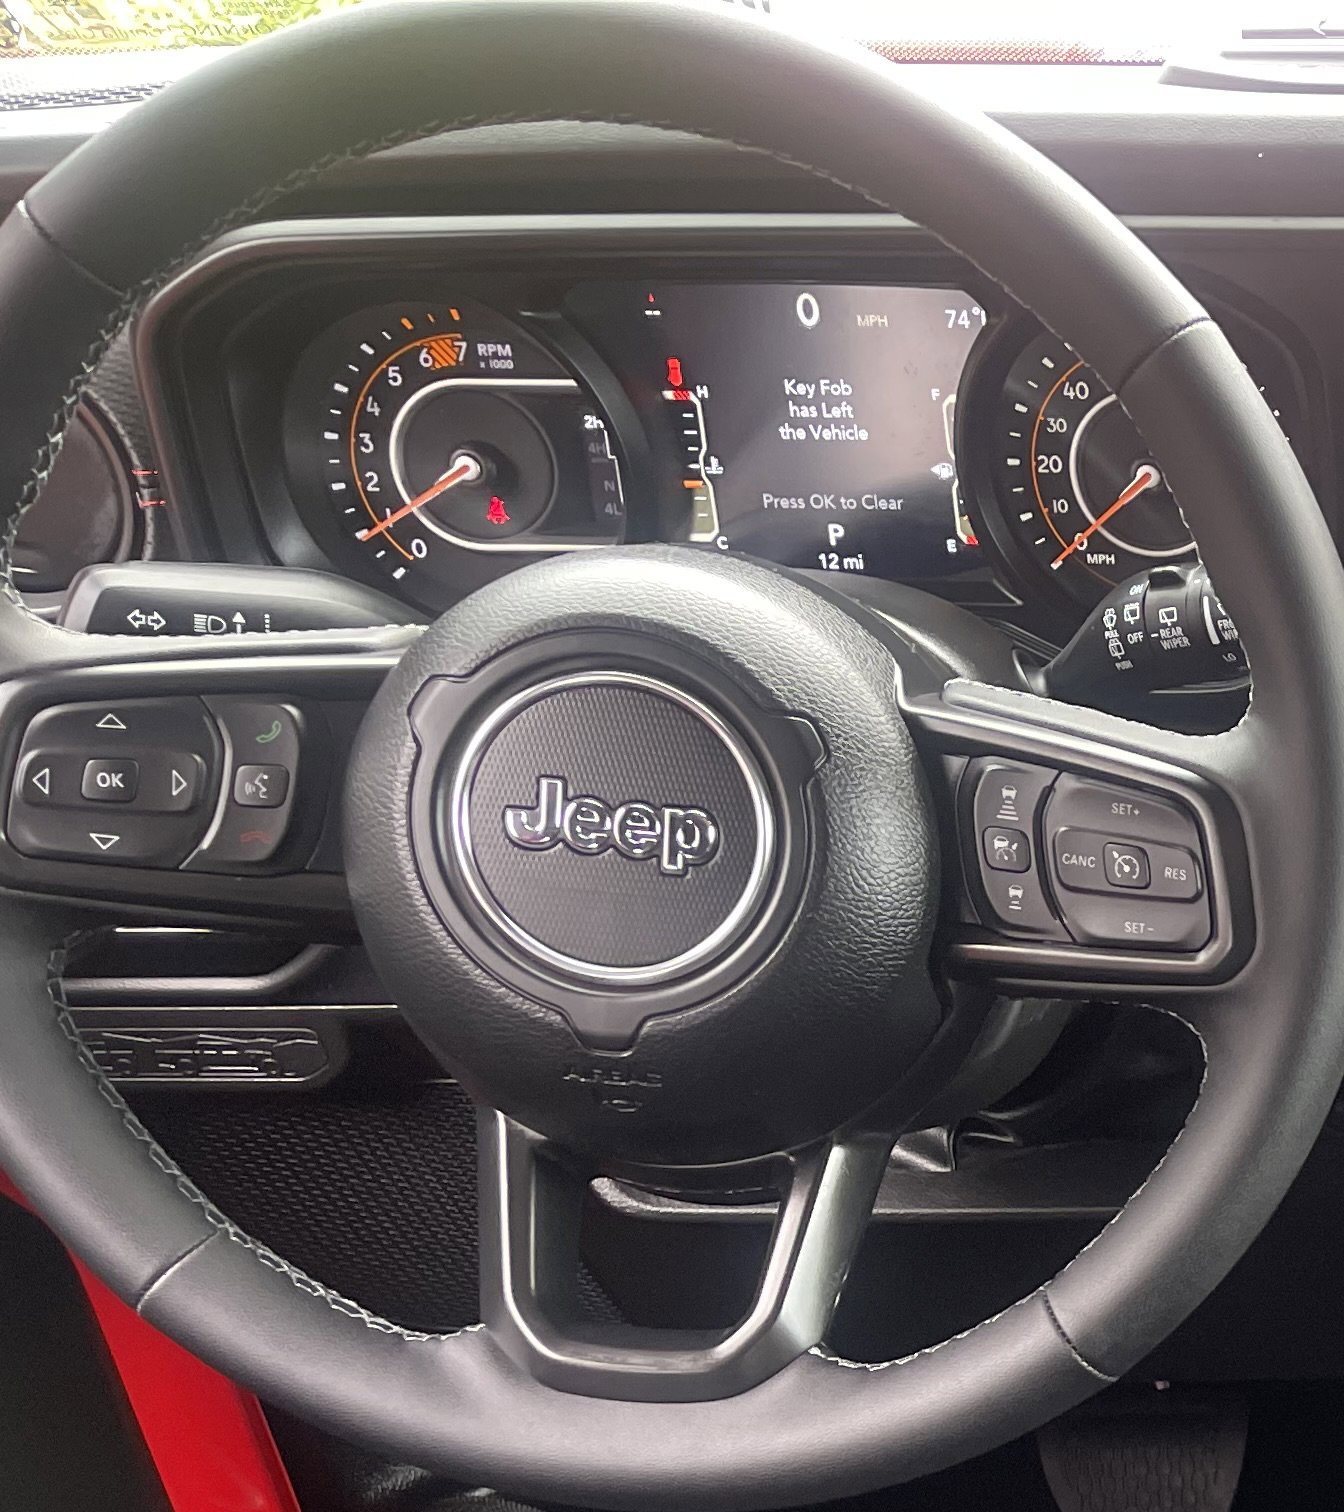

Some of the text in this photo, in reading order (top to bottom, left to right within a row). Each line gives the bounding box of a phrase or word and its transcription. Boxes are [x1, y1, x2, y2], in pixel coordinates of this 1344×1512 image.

[796, 292, 819, 327] 0
[856, 314, 888, 327] MPH
[419, 347, 433, 367] 6
[453, 341, 467, 362] 7
[477, 344, 512, 357] RPM
[489, 359, 514, 369] 1000
[387, 366, 402, 386] 5
[696, 385, 709, 398] H
[784, 379, 852, 399] Key Fob
[931, 389, 940, 400] F
[1063, 381, 1089, 400] 40
[366, 396, 380, 416] 4
[789, 401, 854, 419] has Left
[778, 423, 869, 441] the Vehicle
[1046, 417, 1067, 433] 30
[359, 433, 374, 453] 3
[1037, 455, 1062, 473] 20
[365, 471, 380, 491] 2
[762, 493, 904, 511] Press OK to Clear
[1052, 499, 1068, 513] 10
[716, 536, 729, 549] C
[828, 523, 845, 546] P
[411, 538, 427, 558] 0
[946, 539, 957, 552] E
[818, 553, 864, 570] 12 mi
[1086, 553, 1115, 565] MPH
[1127, 632, 1144, 644] OFF
[1160, 626, 1184, 639] REAR
[1160, 636, 1191, 650] WIPER
[96, 772, 126, 789] OK
[1111, 803, 1140, 816] SET+
[504, 775, 719, 877] Jeep
[1062, 853, 1096, 868] CANC
[1164, 867, 1187, 881] RES
